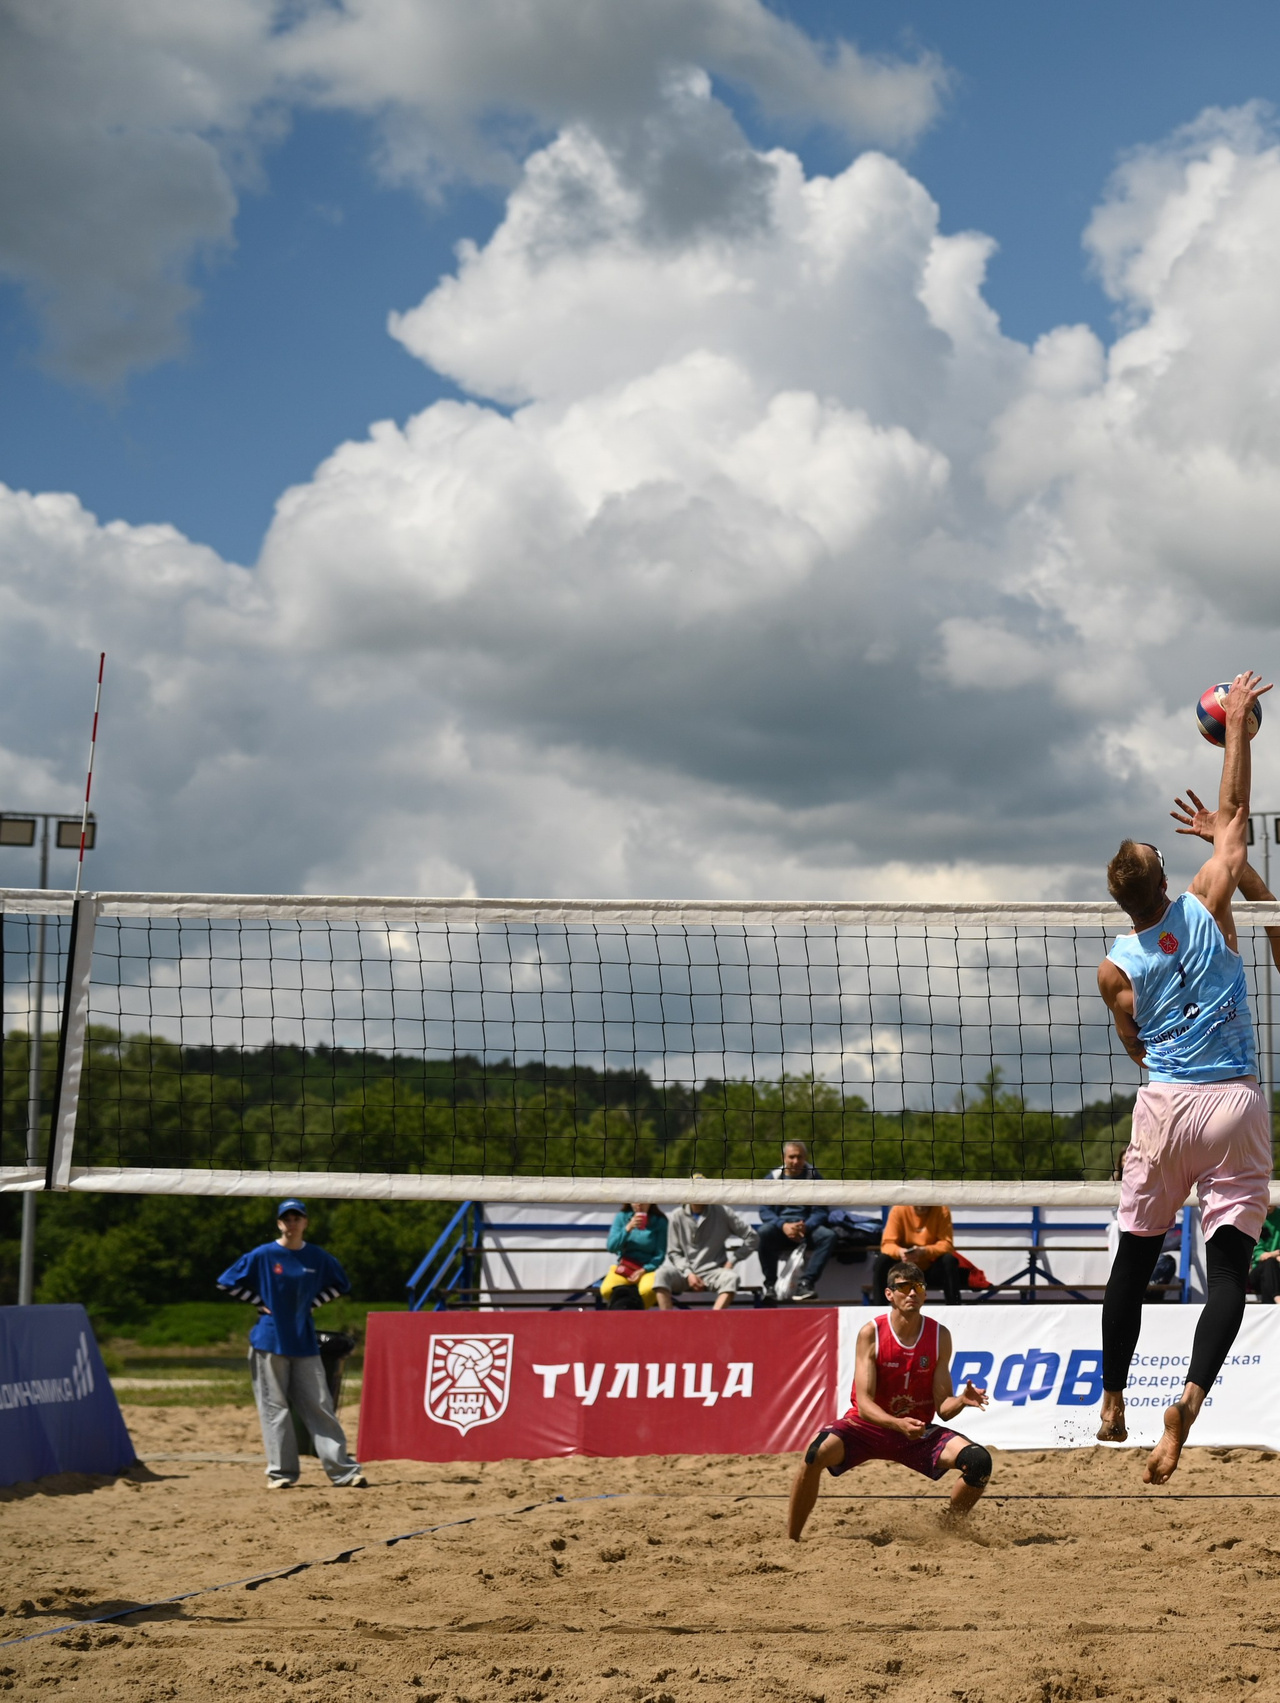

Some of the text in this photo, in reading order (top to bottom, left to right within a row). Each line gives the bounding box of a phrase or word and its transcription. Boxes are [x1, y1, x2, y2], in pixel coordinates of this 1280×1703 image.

[532, 1362, 754, 1407] ТУЛИЦА
[903, 1371, 911, 1390] 1
[950, 1348, 1104, 1407] ВФВ
